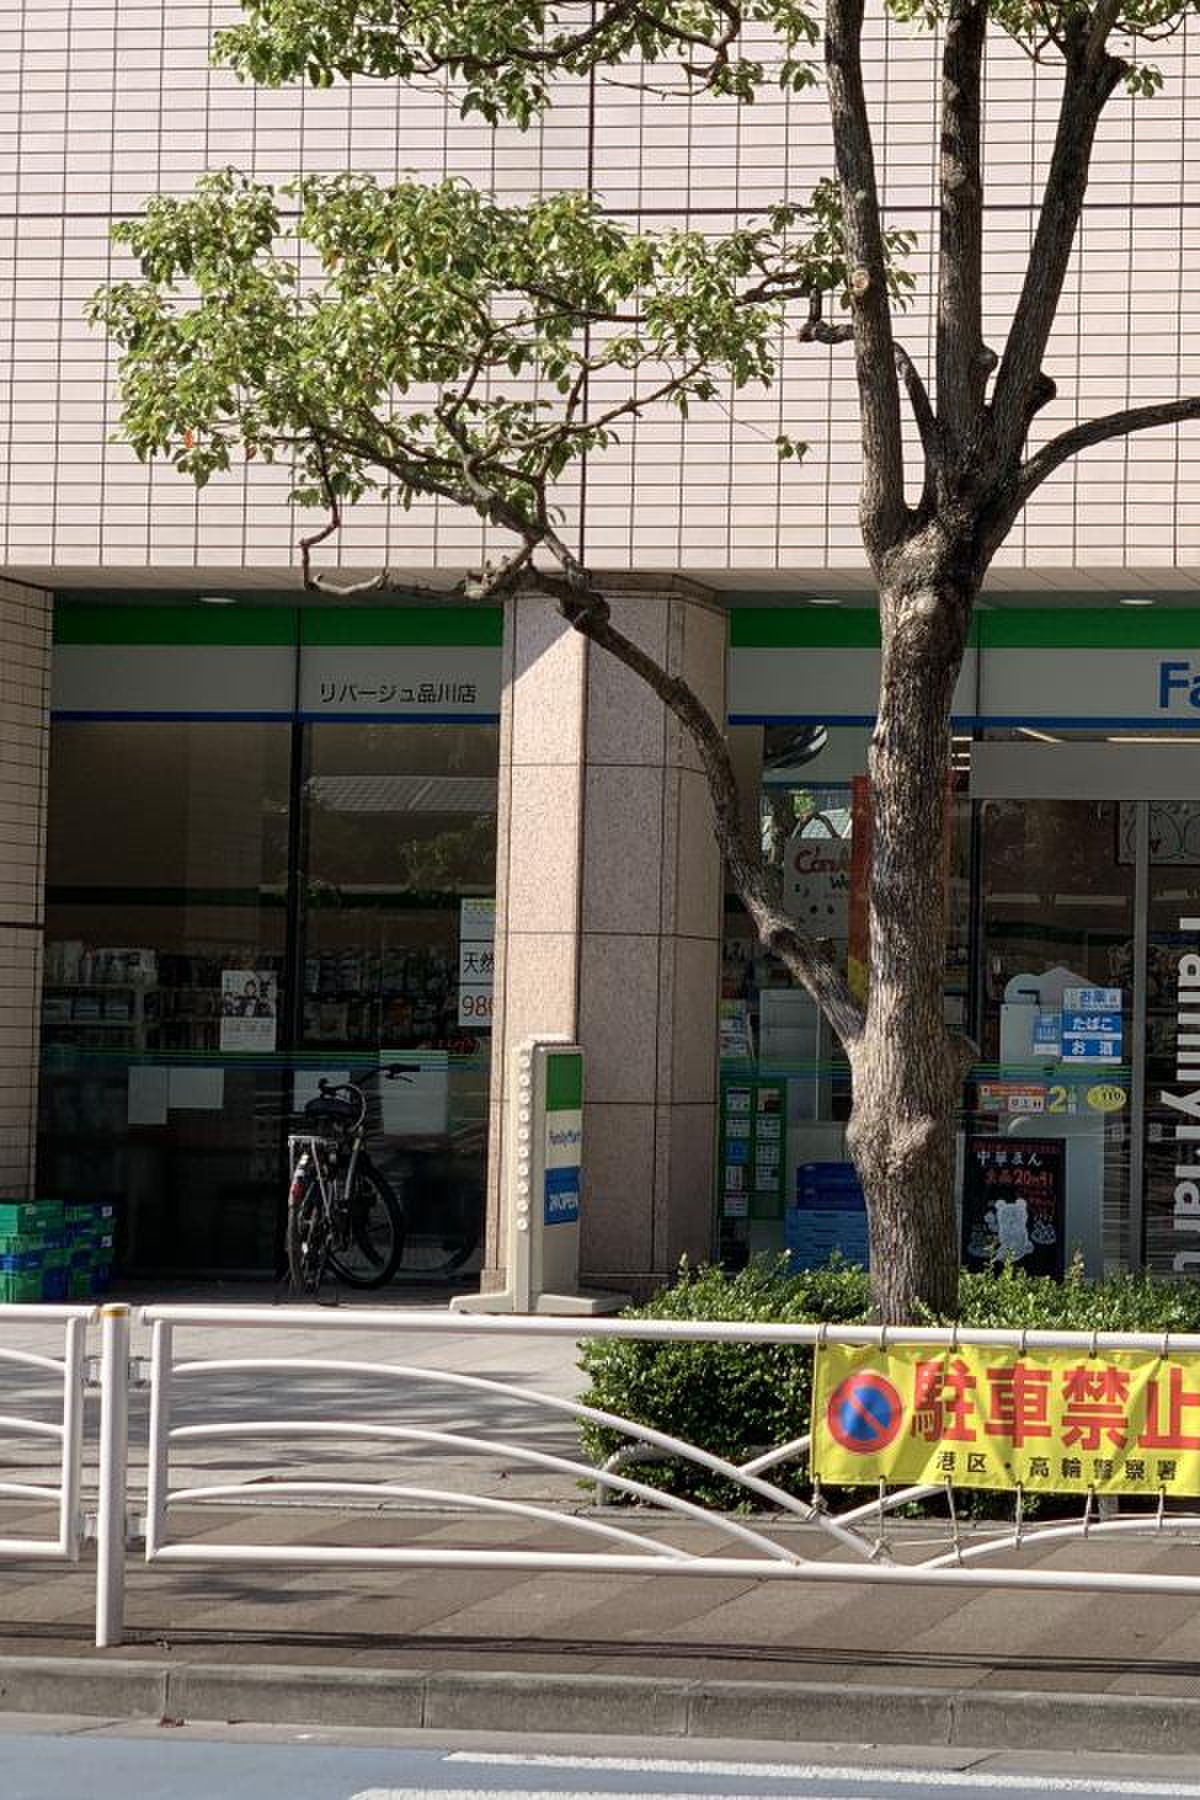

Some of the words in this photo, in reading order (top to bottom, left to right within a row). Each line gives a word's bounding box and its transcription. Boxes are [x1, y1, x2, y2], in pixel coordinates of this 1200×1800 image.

[320, 683, 477, 703] リバージュ品川店
